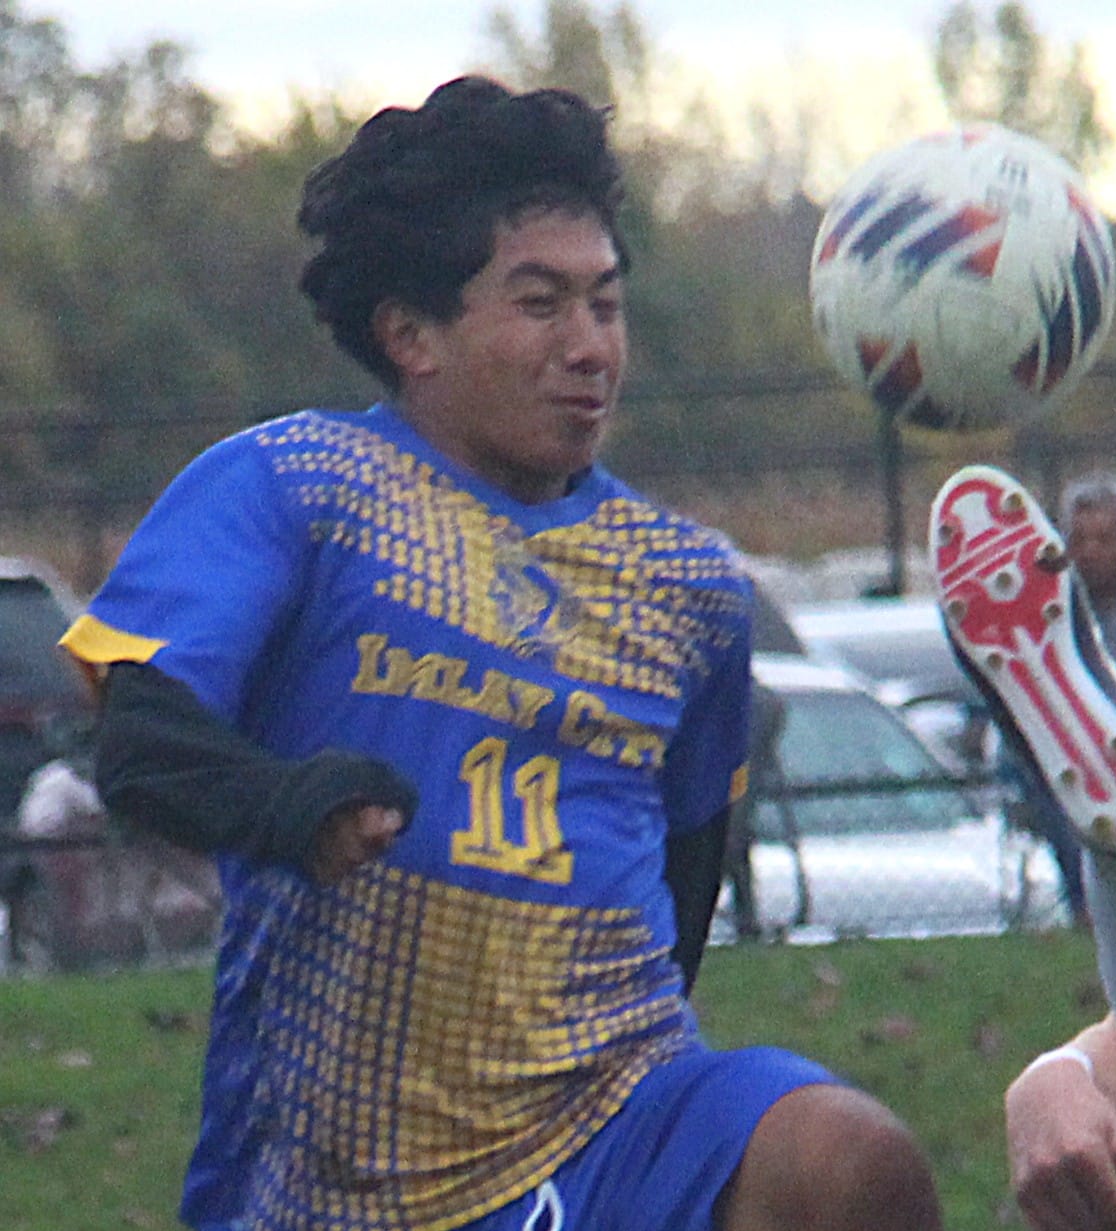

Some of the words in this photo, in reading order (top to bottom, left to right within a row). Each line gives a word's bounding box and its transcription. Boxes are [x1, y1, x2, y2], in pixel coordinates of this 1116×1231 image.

[352, 633, 555, 729] IMLAY
[558, 690, 667, 769] CIT
[450, 737, 574, 885] 11
